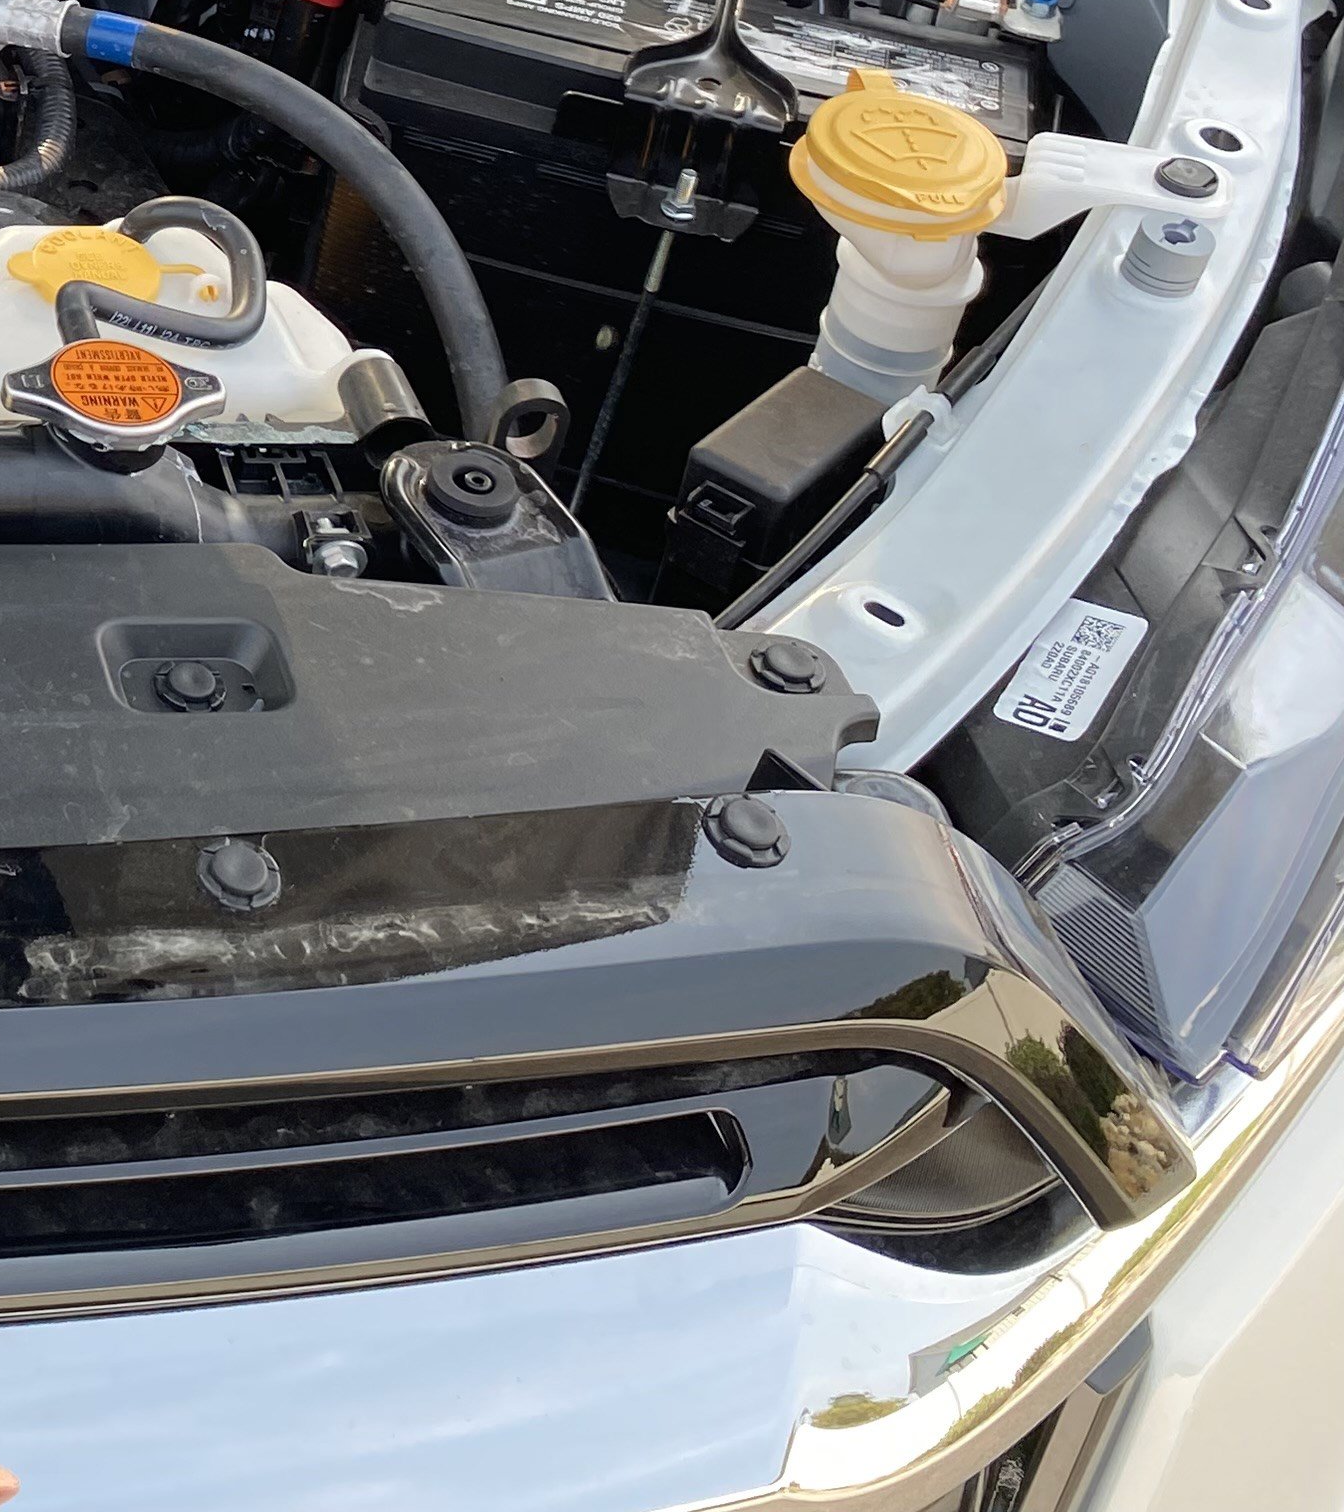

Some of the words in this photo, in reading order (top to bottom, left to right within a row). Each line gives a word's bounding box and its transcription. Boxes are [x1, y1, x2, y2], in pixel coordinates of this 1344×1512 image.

[554, 1, 596, 16] AMPS
[914, 192, 965, 205] PULL
[41, 230, 141, 255] COOLANT
[86, 373, 110, 381] WHEN
[114, 374, 136, 382] OPEN
[141, 374, 168, 383] NEVER
[81, 394, 140, 407] WARNING
[1047, 645, 1079, 683] SUBARU
[1012, 693, 1058, 729] AD
